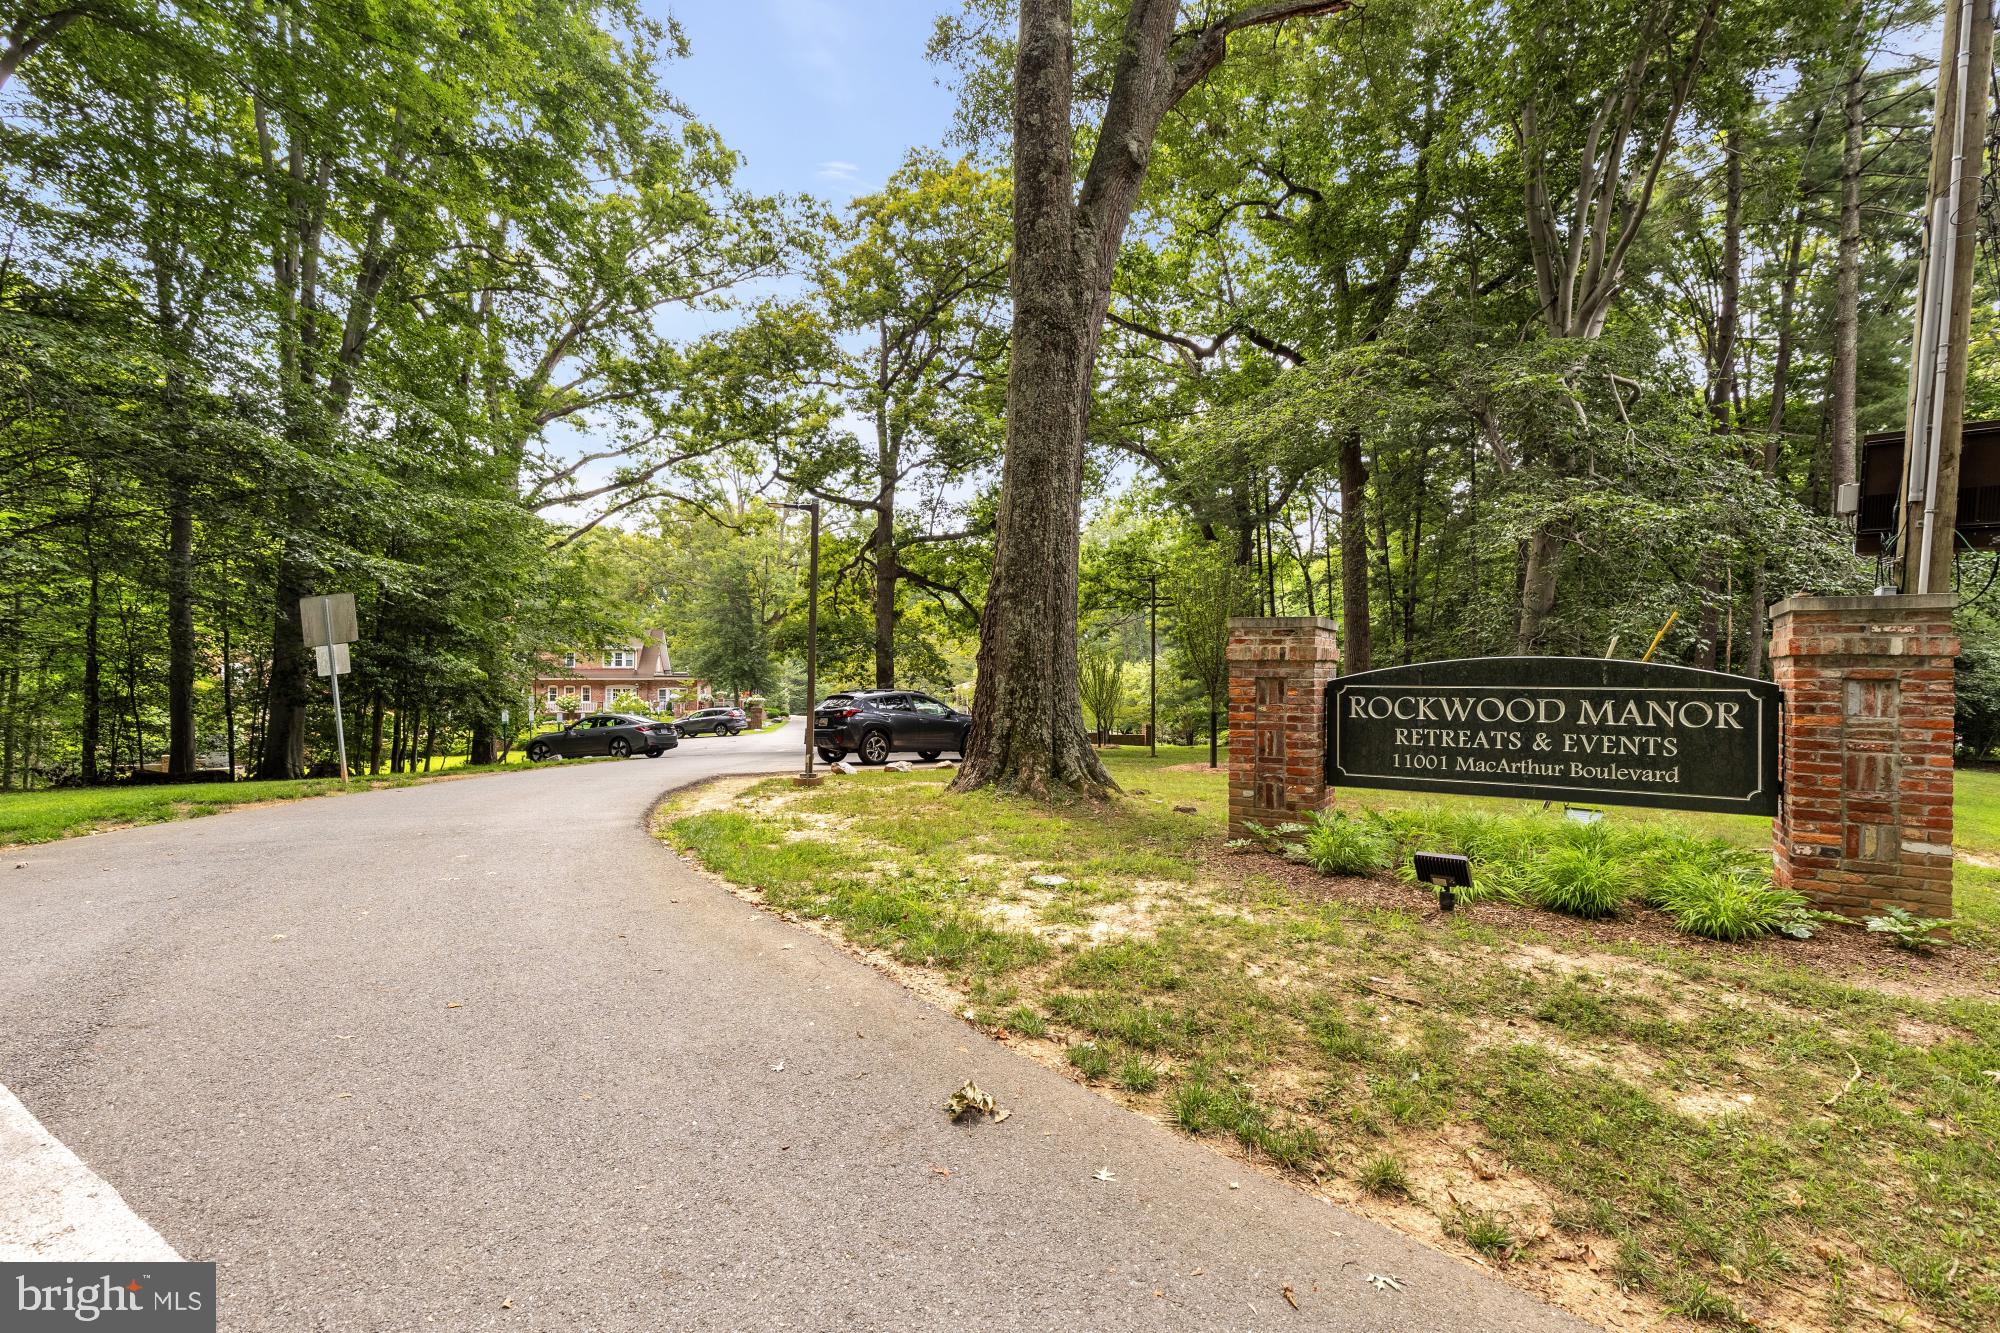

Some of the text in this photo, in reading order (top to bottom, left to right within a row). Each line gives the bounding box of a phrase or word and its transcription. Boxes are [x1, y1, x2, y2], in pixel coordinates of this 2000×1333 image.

[1349, 696, 1744, 729] ROCKWOOD MANOR
[1395, 727, 1678, 757] RETREATS & EVENTS
[1392, 753, 1680, 784] 11001 MacArthur Boulevard
